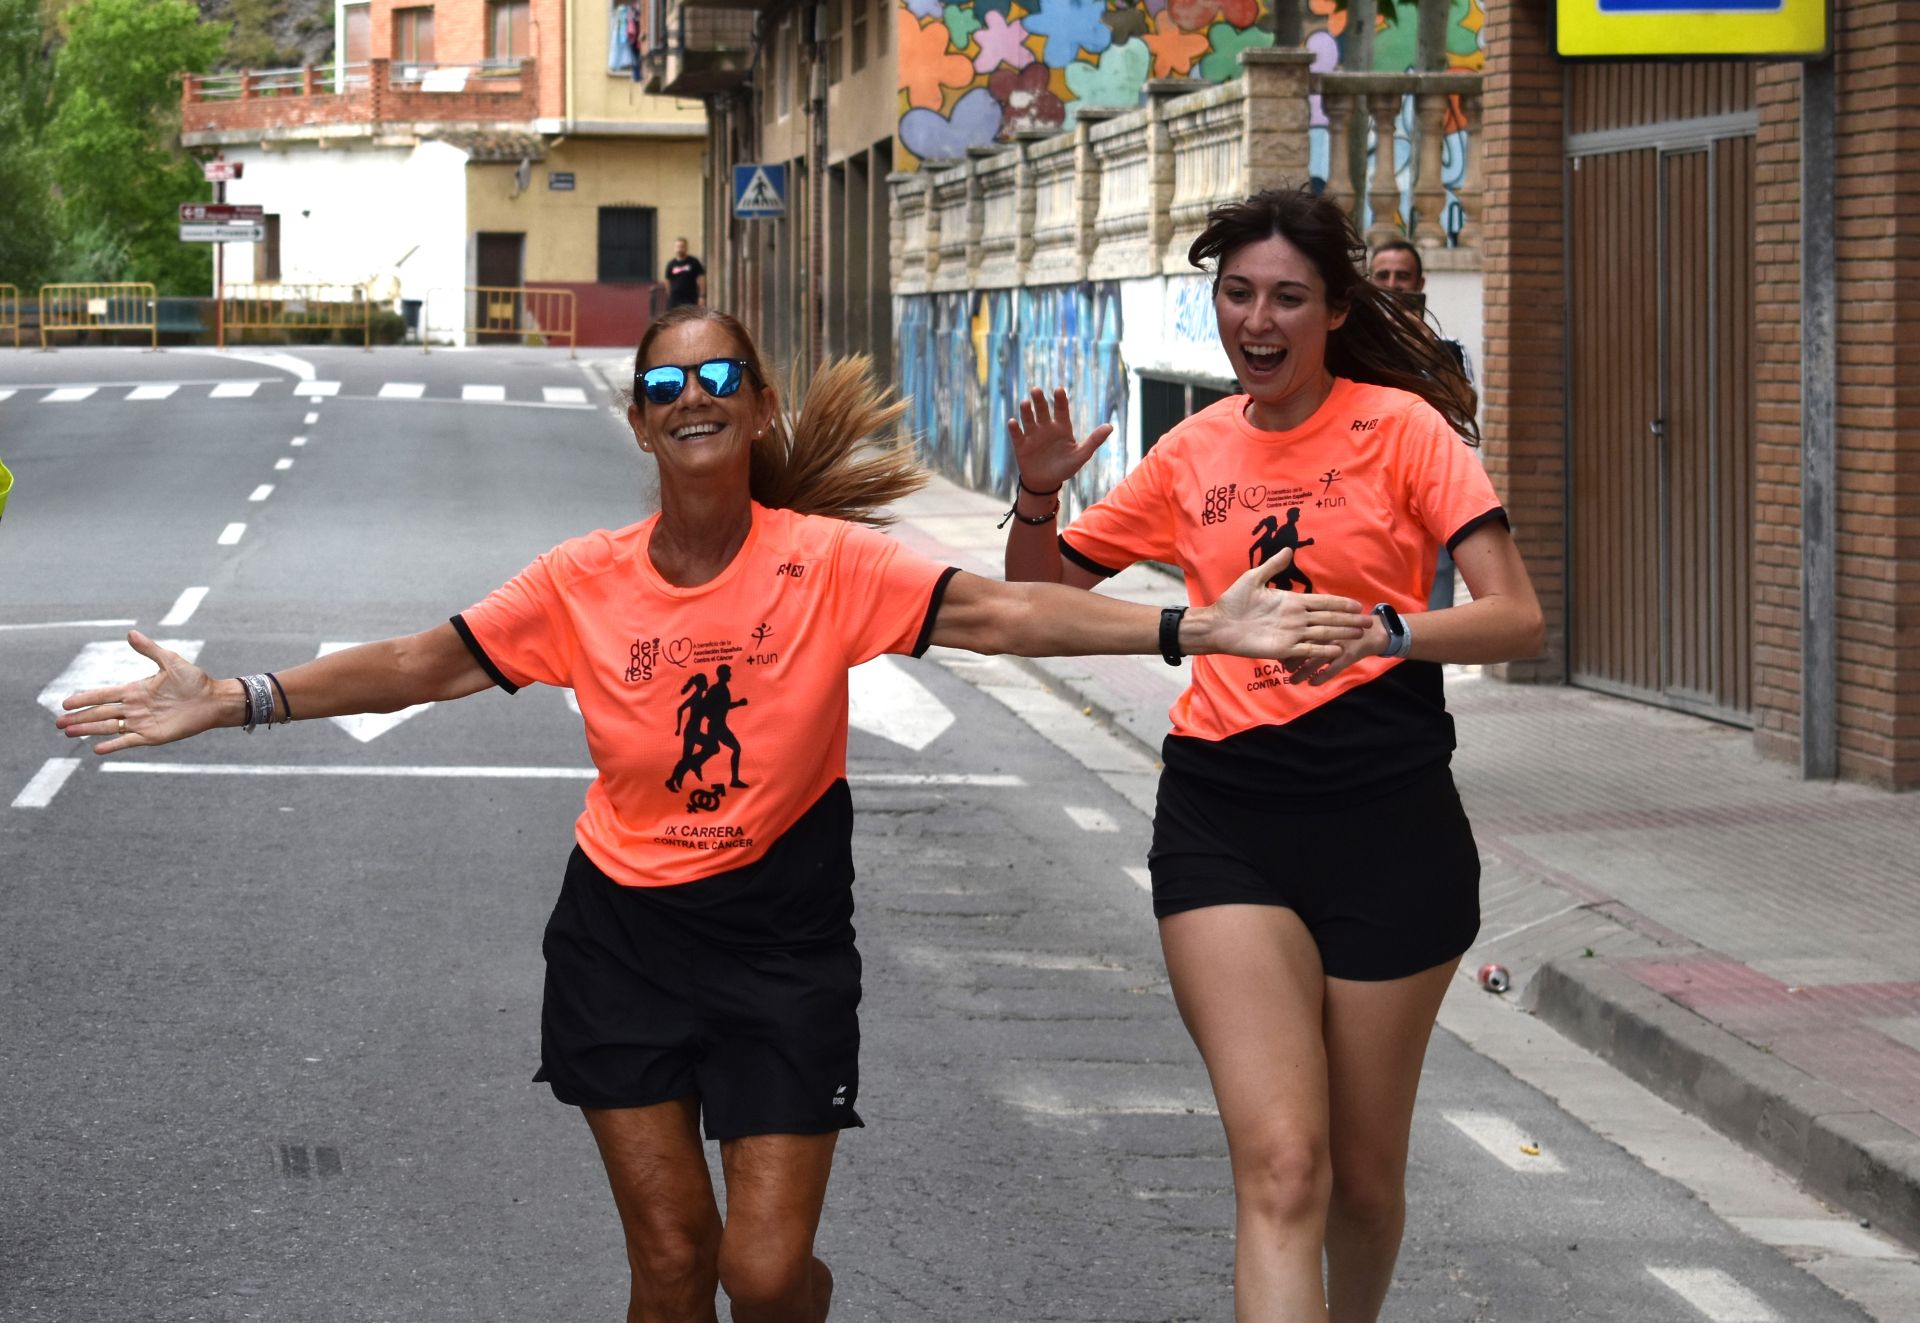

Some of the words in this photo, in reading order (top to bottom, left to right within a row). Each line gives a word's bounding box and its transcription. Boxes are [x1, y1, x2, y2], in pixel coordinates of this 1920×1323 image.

[1247, 678, 1280, 691] CONTRA
[664, 825, 678, 836] IX
[680, 826, 744, 838] CARRERA
[653, 838, 695, 849] CONTRA
[697, 840, 710, 850] EL
